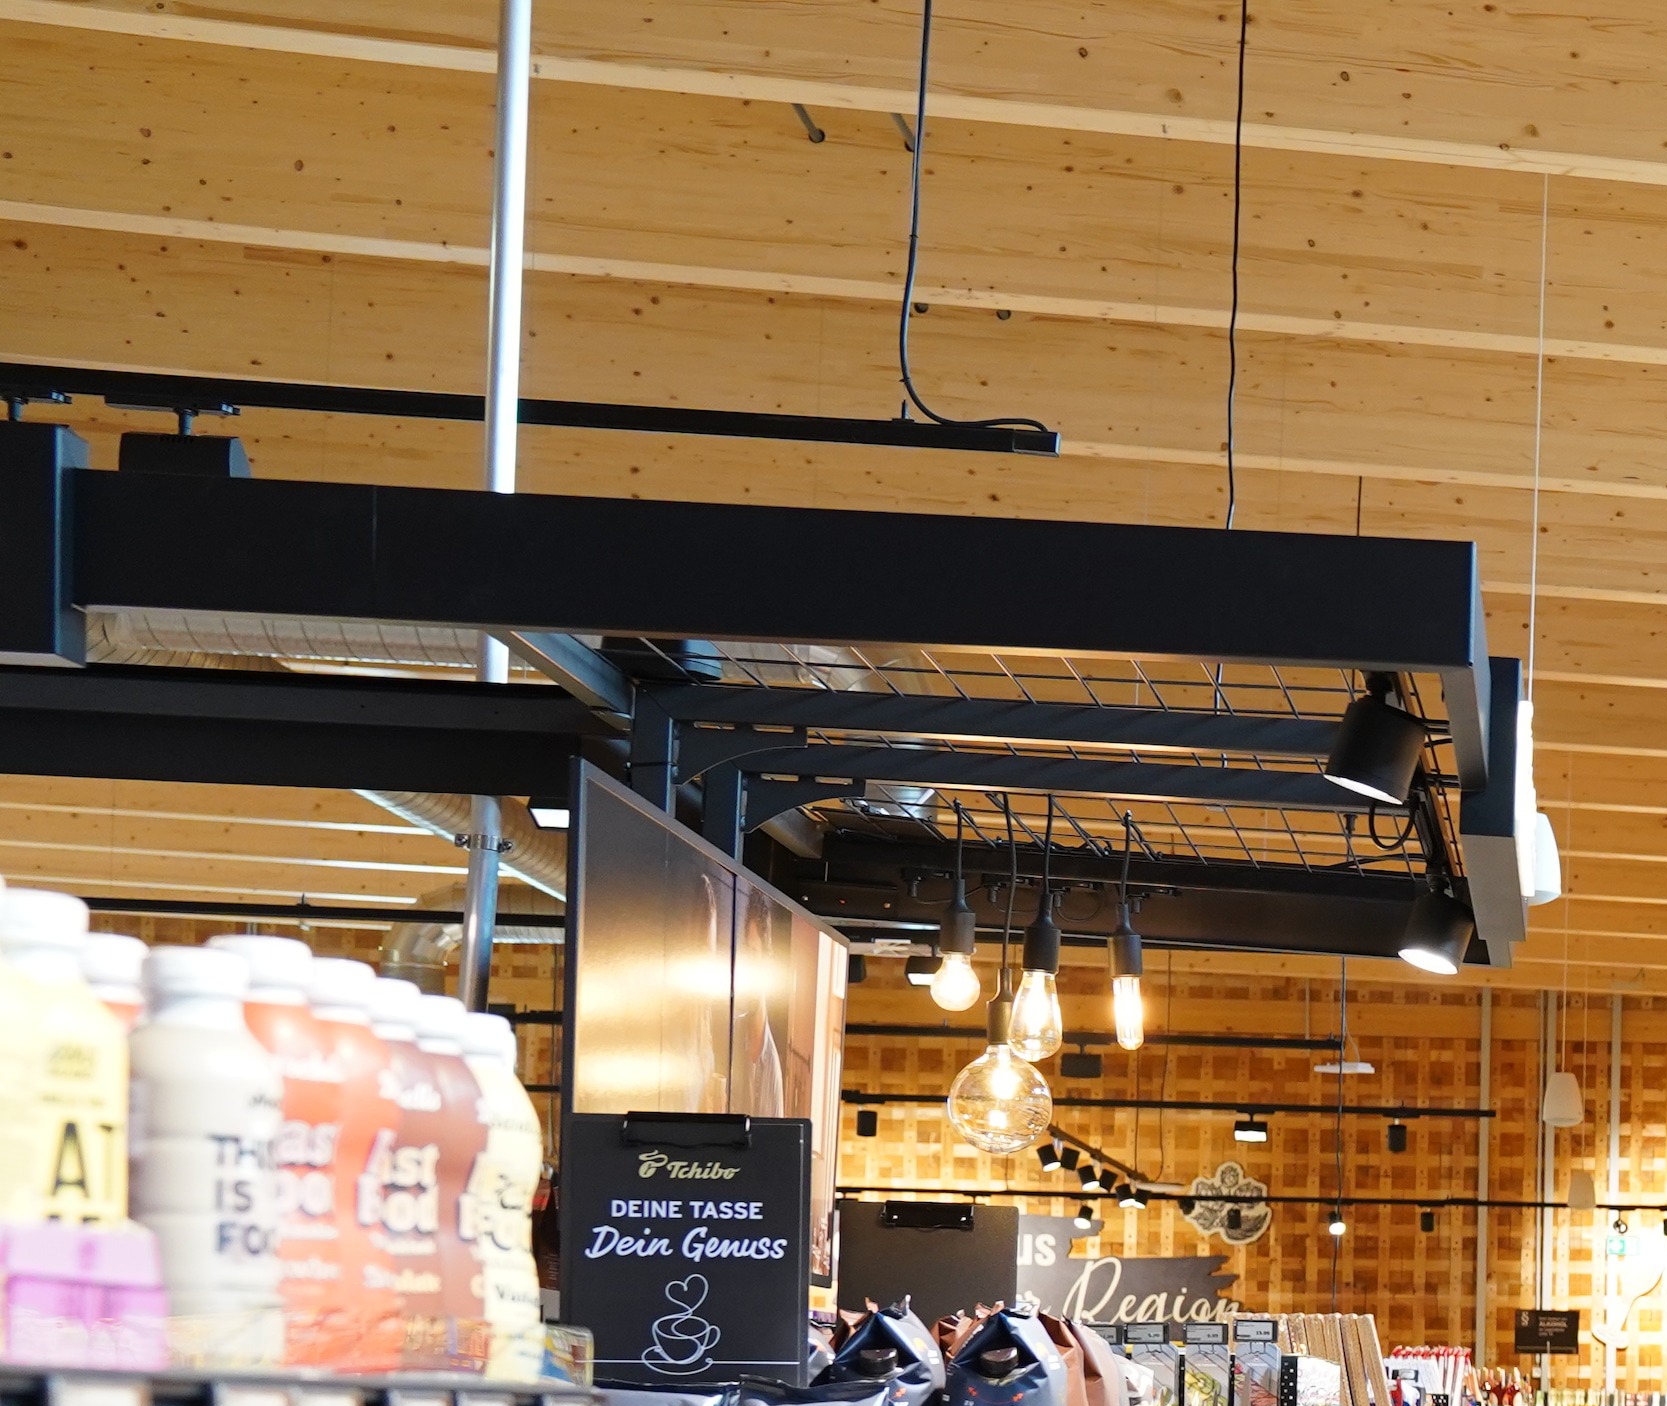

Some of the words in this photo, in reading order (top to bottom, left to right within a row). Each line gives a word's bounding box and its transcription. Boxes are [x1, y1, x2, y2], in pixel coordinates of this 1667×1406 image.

[666, 1161, 741, 1180] Tchibo
[611, 1200, 683, 1218] DEINE
[690, 1201, 763, 1220] TASSE
[584, 1225, 673, 1259] Dein
[682, 1226, 788, 1262] Genuss
[1018, 1234, 1056, 1266] us
